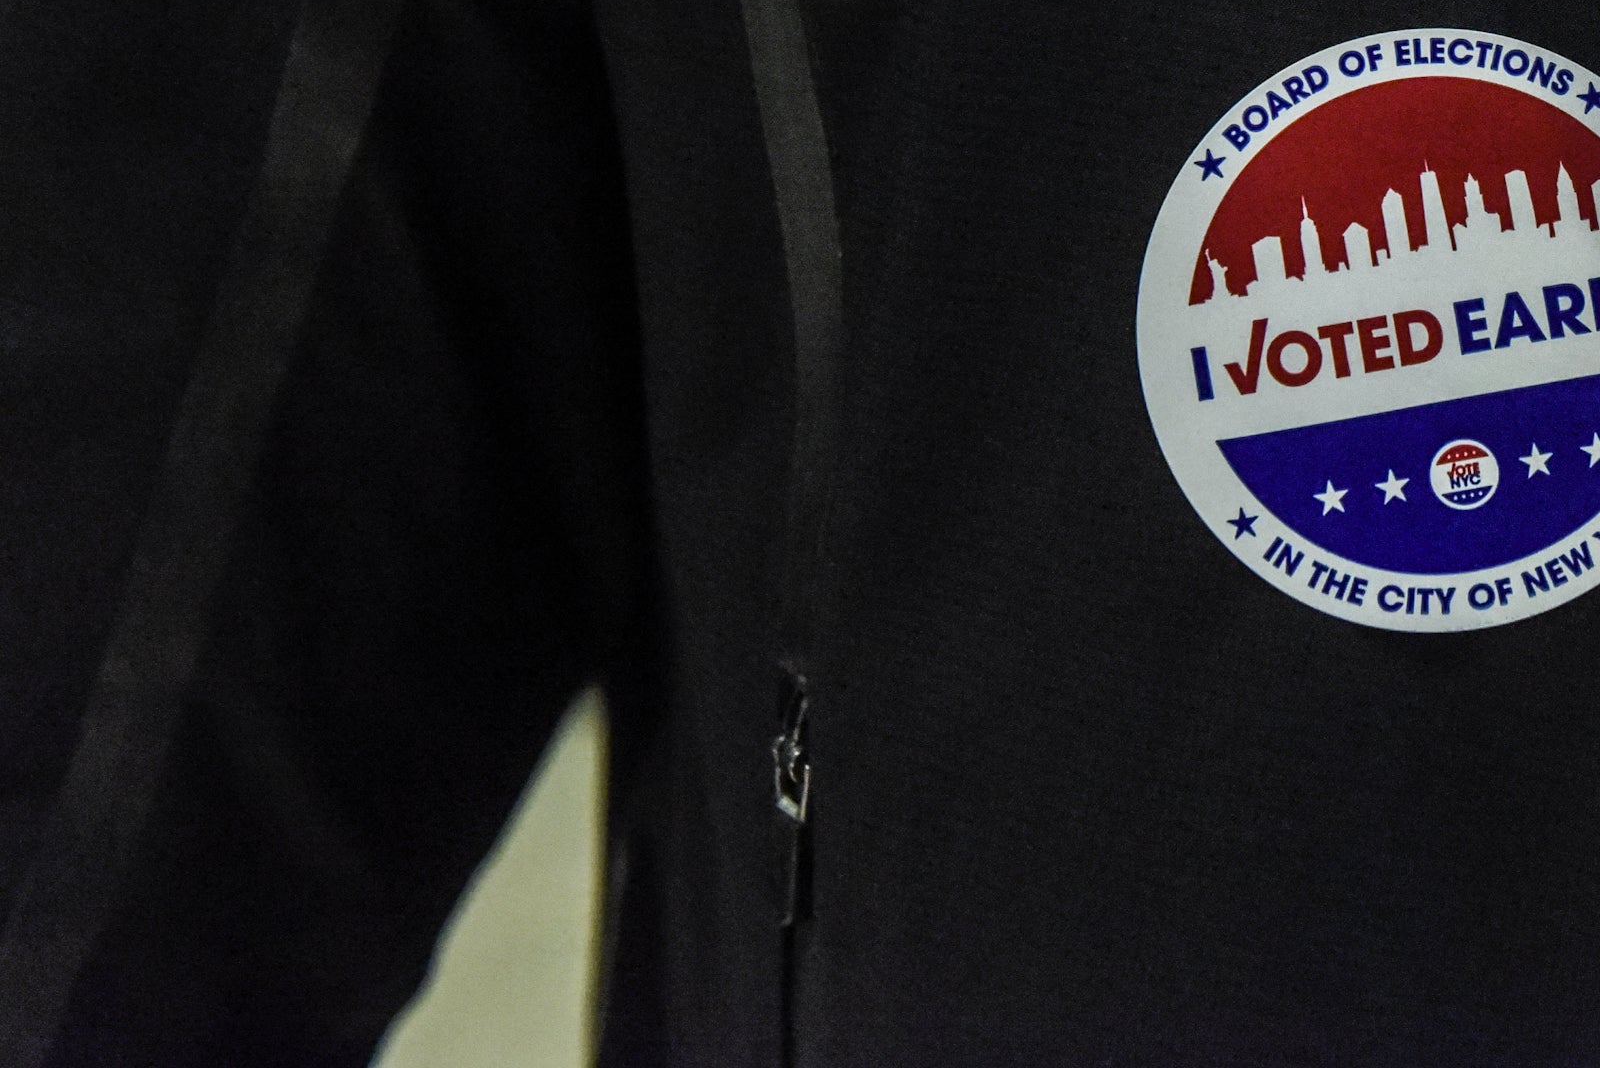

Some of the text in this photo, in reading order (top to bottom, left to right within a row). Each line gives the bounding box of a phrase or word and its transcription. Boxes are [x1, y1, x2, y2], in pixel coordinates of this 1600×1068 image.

[1221, 37, 1575, 152] BOARD OF ELECTIONS
[1190, 346, 1215, 402] I
[1223, 309, 1444, 396] VOTED
[1447, 462, 1480, 479] VOTE
[1450, 474, 1481, 489] NYC
[1262, 536, 1305, 578] IN
[1307, 560, 1369, 607] THE
[1377, 584, 1457, 616] CITY
[1467, 577, 1513, 611] OF
[1520, 540, 1595, 598] NEW
